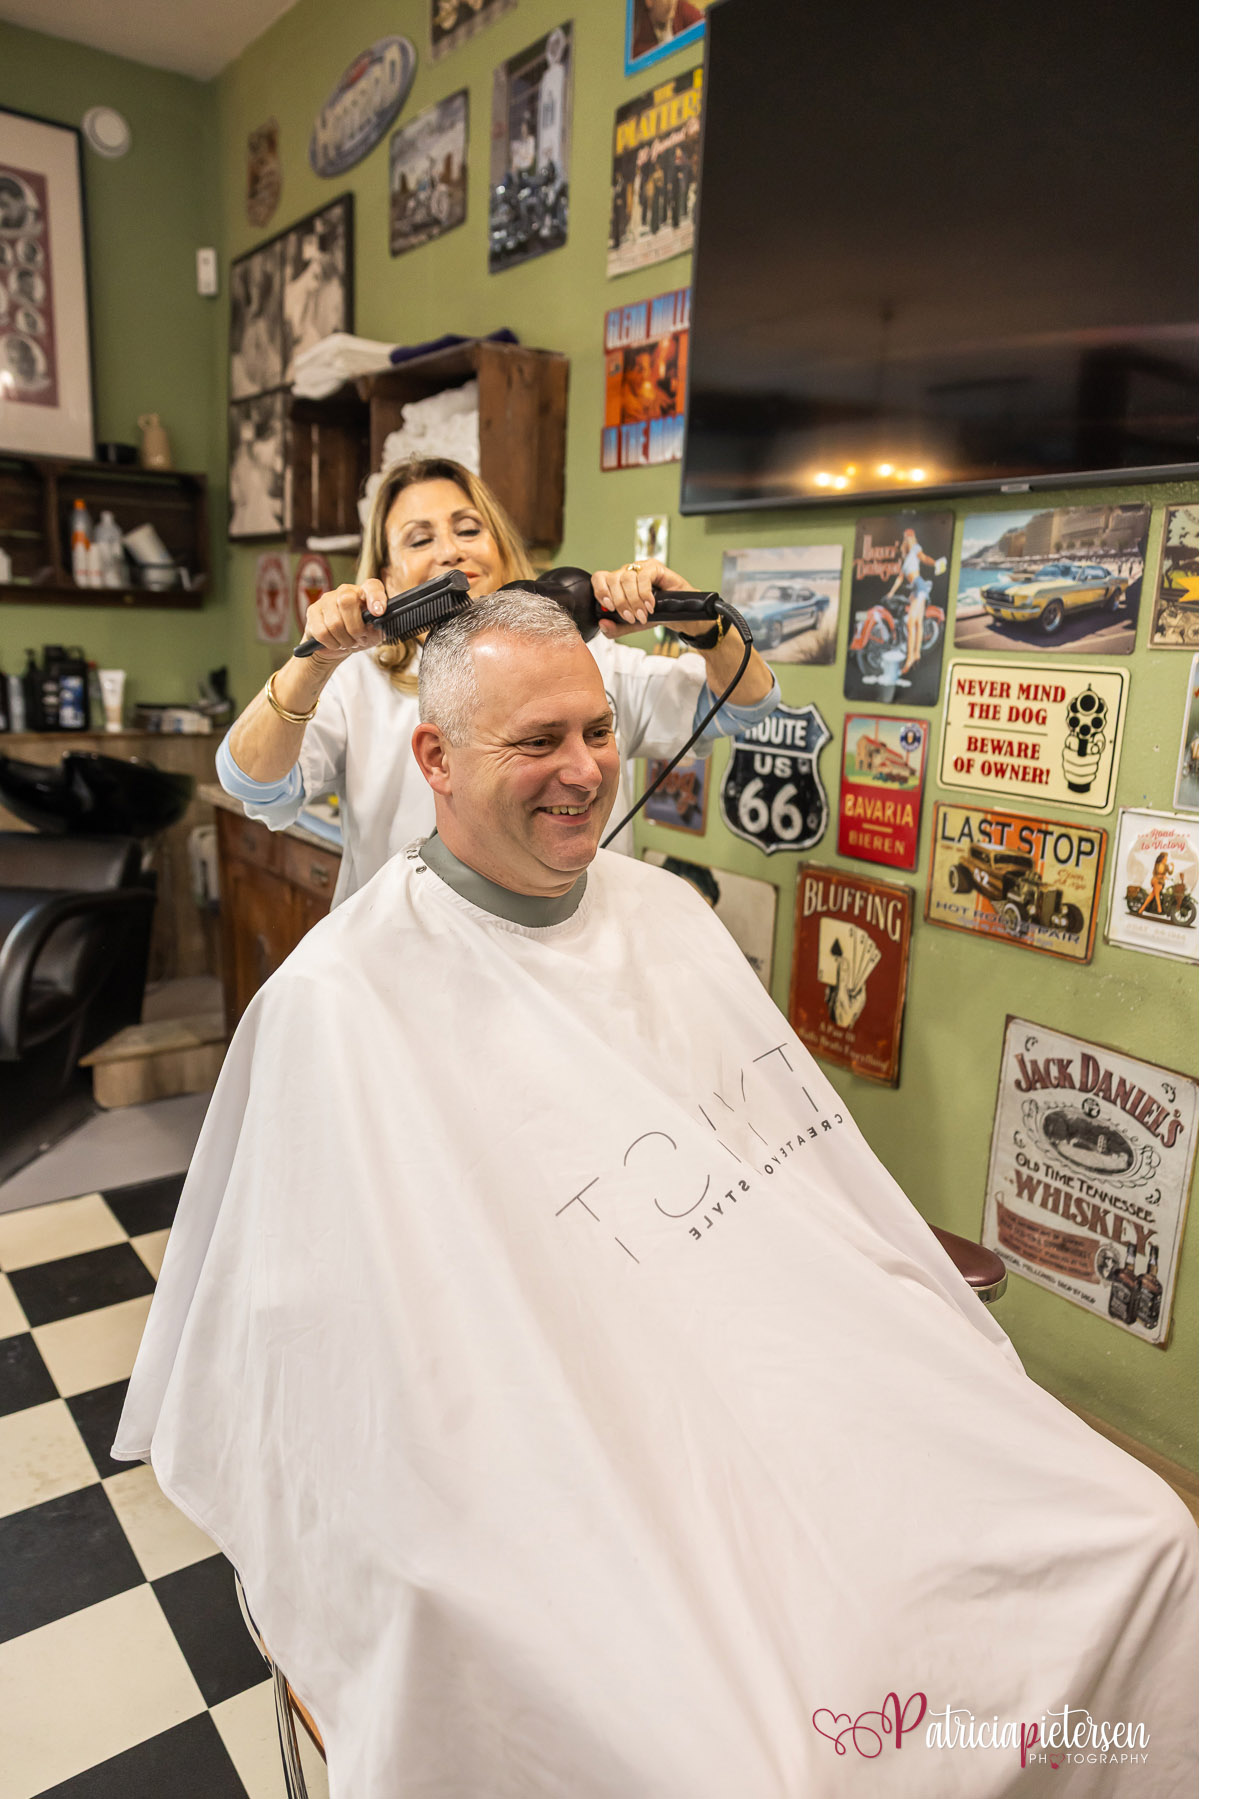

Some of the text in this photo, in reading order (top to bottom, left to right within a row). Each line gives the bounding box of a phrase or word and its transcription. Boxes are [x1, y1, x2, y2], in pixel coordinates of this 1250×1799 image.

[650, 287, 690, 337] MILL
[620, 420, 649, 467] THE
[649, 414, 685, 464] MOO
[955, 677, 1067, 704] NEVER MIND
[967, 701, 1048, 726] THE DOG
[966, 735, 1041, 761] BEWARE
[753, 752, 793, 778] US
[953, 756, 1051, 785] OF OWNER!
[738, 776, 804, 841] 66
[844, 794, 914, 828] BAVARIA
[848, 829, 906, 855] BIEREN
[940, 811, 1096, 868] LAST STOP
[1141, 840, 1187, 852] to Victory
[1150, 827, 1175, 840] Road
[803, 876, 903, 944] BLUFFING
[935, 900, 969, 914] HOT
[1013, 1051, 1078, 1093] JACK
[1015, 1151, 1156, 1223] OLD TIME TENNESSEE
[1013, 1168, 1158, 1257] WHISKEY
